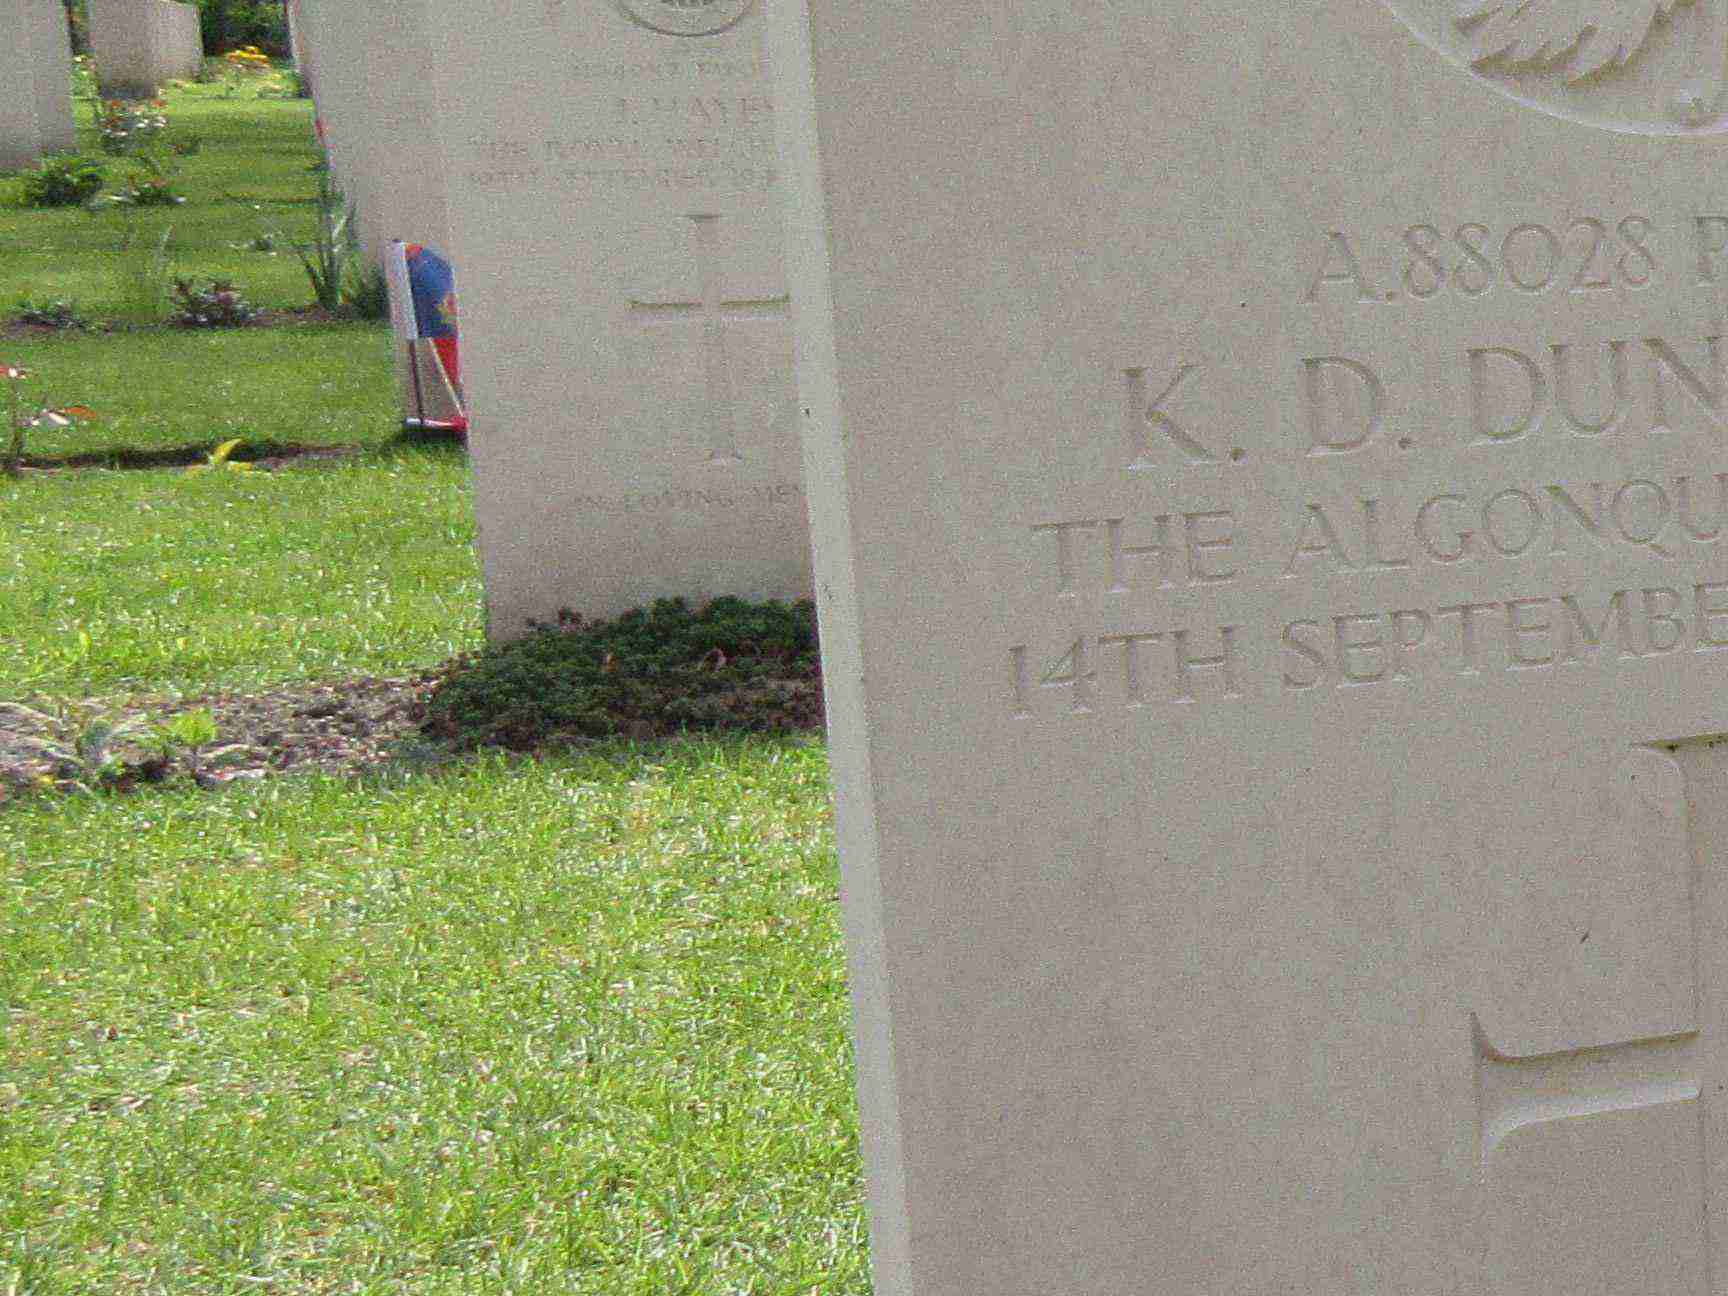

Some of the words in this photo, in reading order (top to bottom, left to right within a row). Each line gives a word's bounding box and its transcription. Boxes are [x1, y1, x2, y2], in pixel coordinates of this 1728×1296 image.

[1301, 214, 1655, 306] A.88028
[1120, 362, 1250, 472] K.
[1300, 354, 1412, 458] D.
[1031, 508, 1236, 600] THE
[1004, 624, 1243, 722] 14TH
